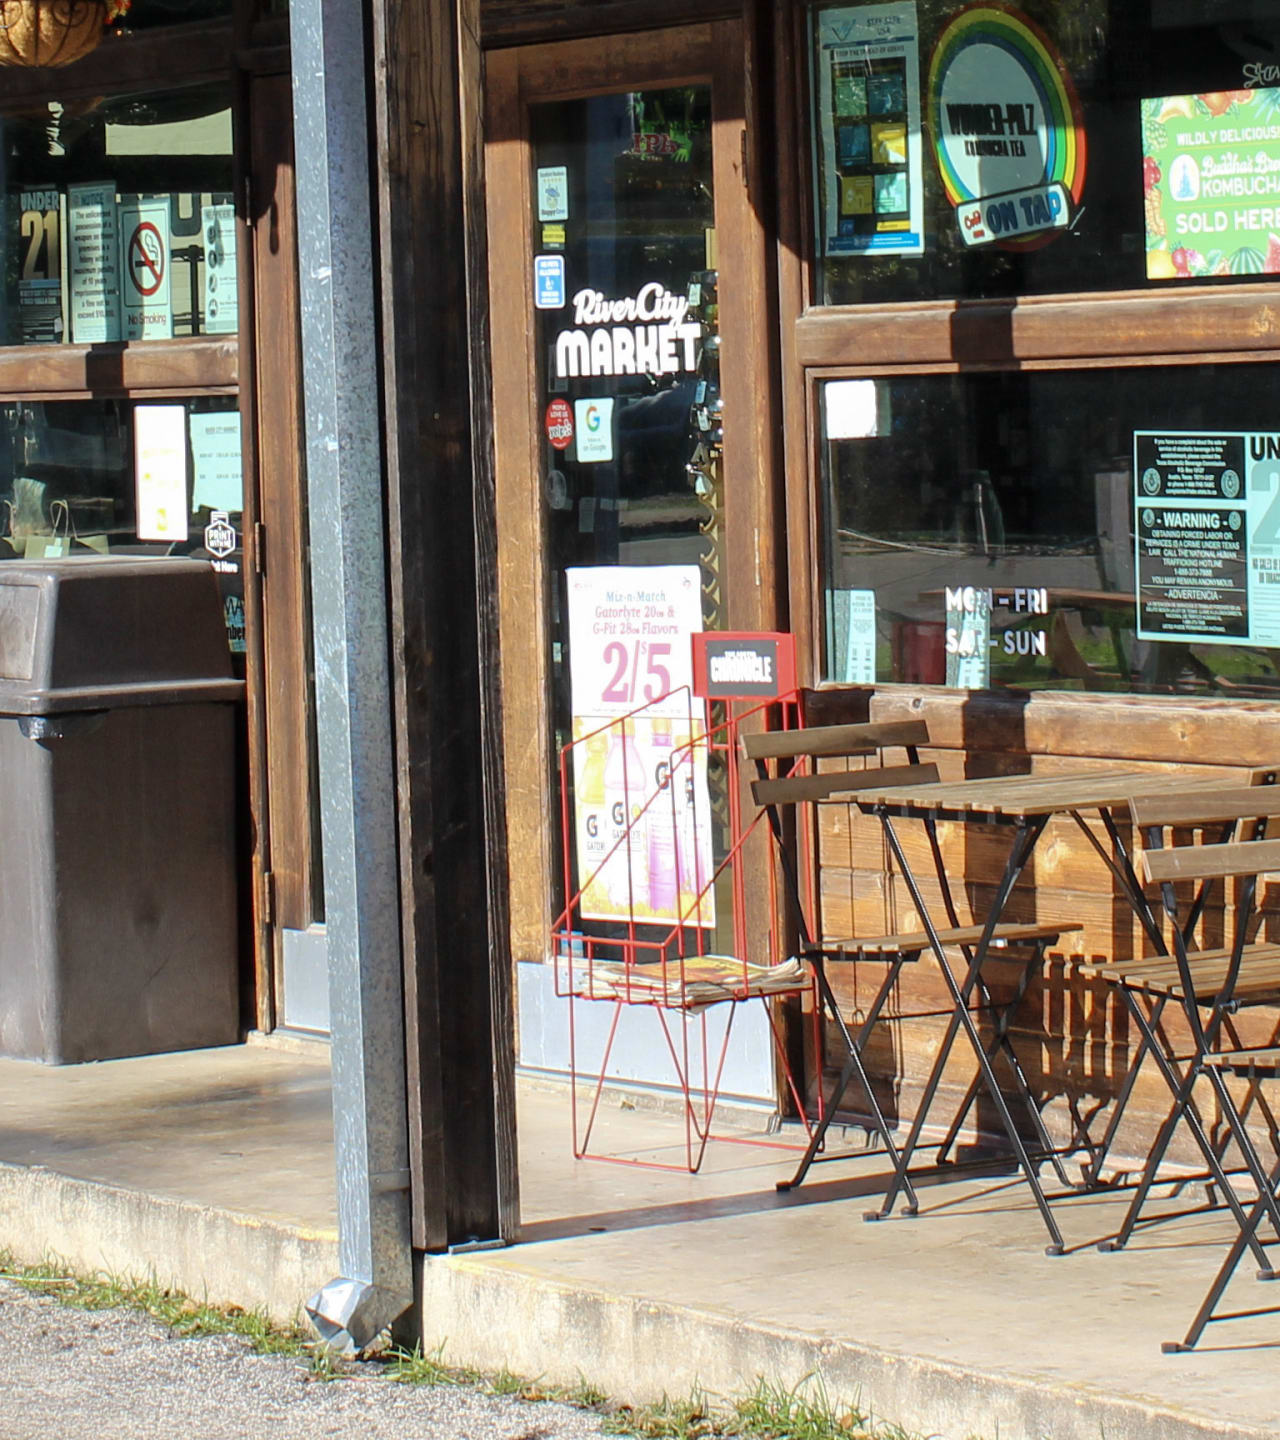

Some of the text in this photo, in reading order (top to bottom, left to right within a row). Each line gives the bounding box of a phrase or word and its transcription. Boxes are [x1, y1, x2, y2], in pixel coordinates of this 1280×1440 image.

[1176, 125, 1280, 146] WILDLY DELICIOUS!
[1009, 140, 1027, 157] TEA
[20, 190, 60, 211] UNDER
[986, 200, 1019, 235] ON
[1020, 190, 1062, 227] TAP
[1175, 210, 1228, 234] SOLD
[20, 210, 59, 281] 21
[127, 312, 167, 327] No Smoking
[556, 322, 701, 378] MARKET
[1162, 511, 1220, 529] WARNING
[208, 529, 231, 539] PRINT
[1181, 530, 1204, 539] FORCED
[1204, 531, 1223, 540] LABOR
[1223, 532, 1233, 540] OR
[1162, 548, 1177, 557] CALL
[1222, 541, 1240, 550] TEXAS
[945, 585, 993, 612] MON
[1014, 587, 1048, 615] FRI
[594, 605, 641, 621] Gatorlyte
[667, 605, 675, 619] &
[641, 622, 679, 635] Flavors
[1003, 630, 1047, 656] SUN
